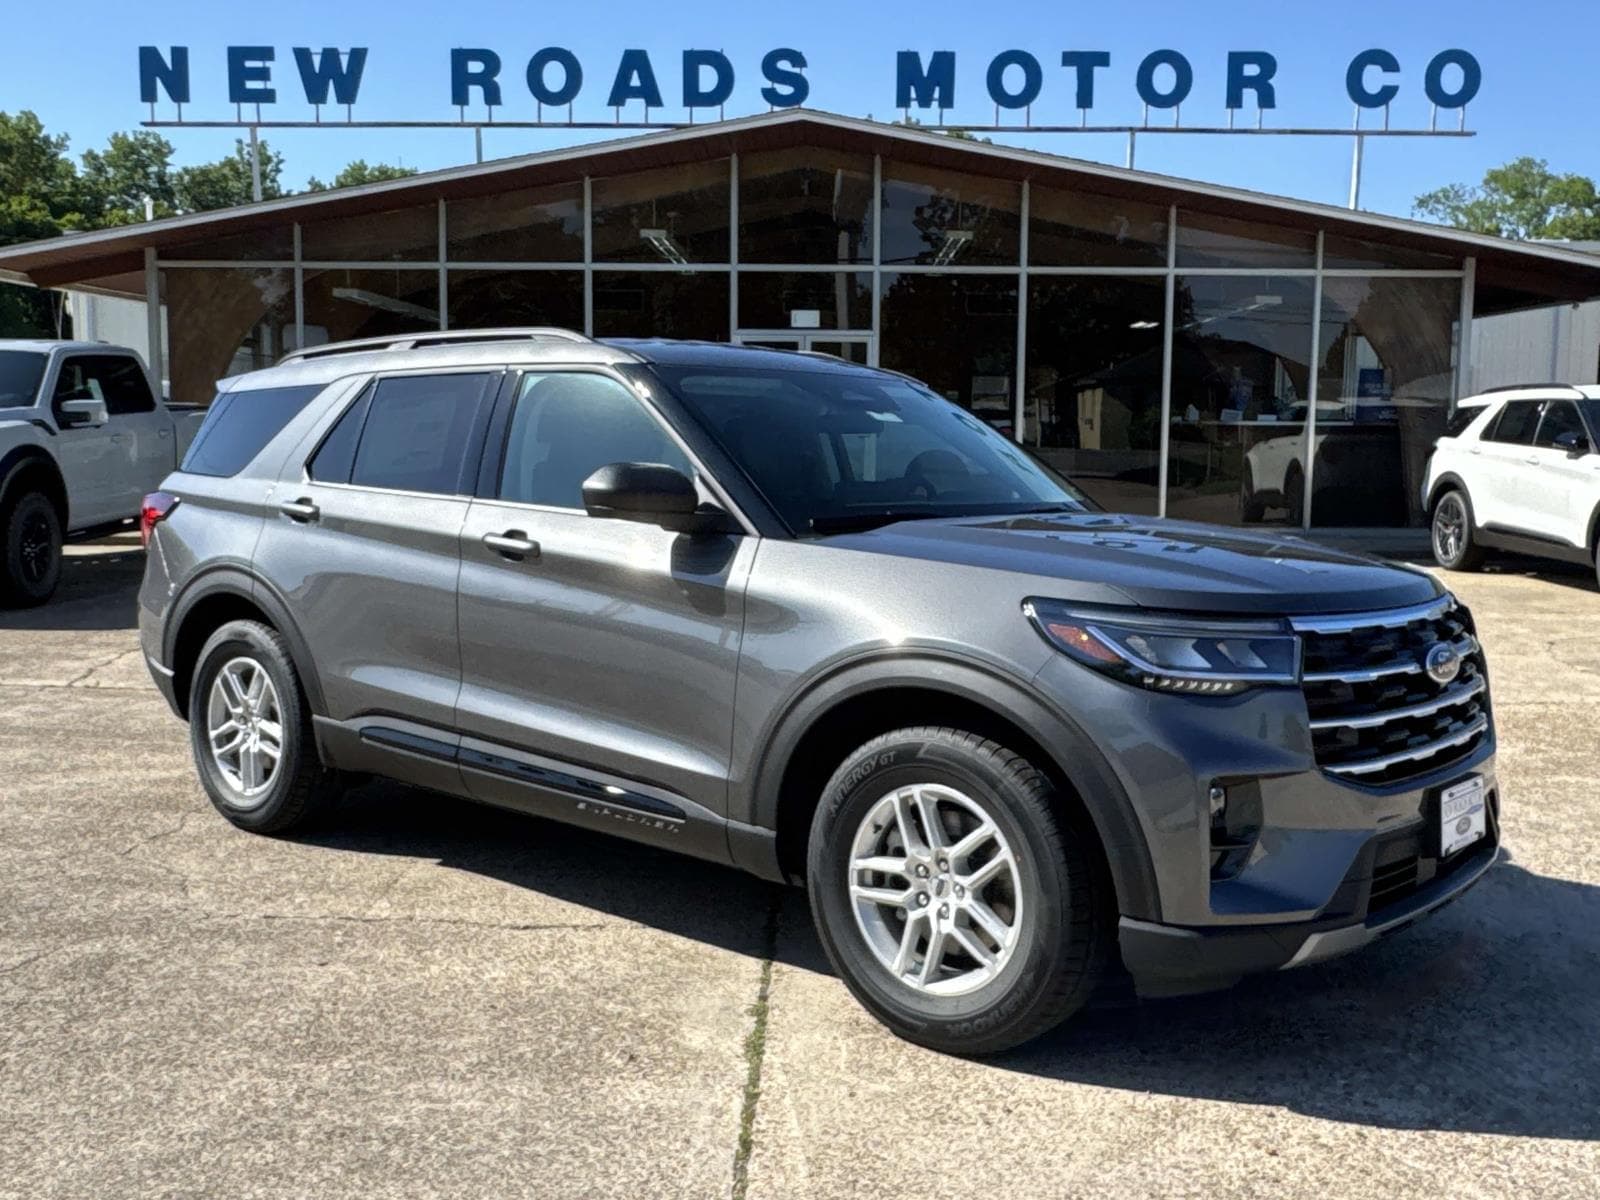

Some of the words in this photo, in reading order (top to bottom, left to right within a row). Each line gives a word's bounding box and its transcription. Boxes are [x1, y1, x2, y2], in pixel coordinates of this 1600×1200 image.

[138, 45, 368, 105] NEW
[450, 46, 811, 109] ROADS
[896, 49, 1277, 110] MOTOR
[1345, 48, 1482, 110] CO
